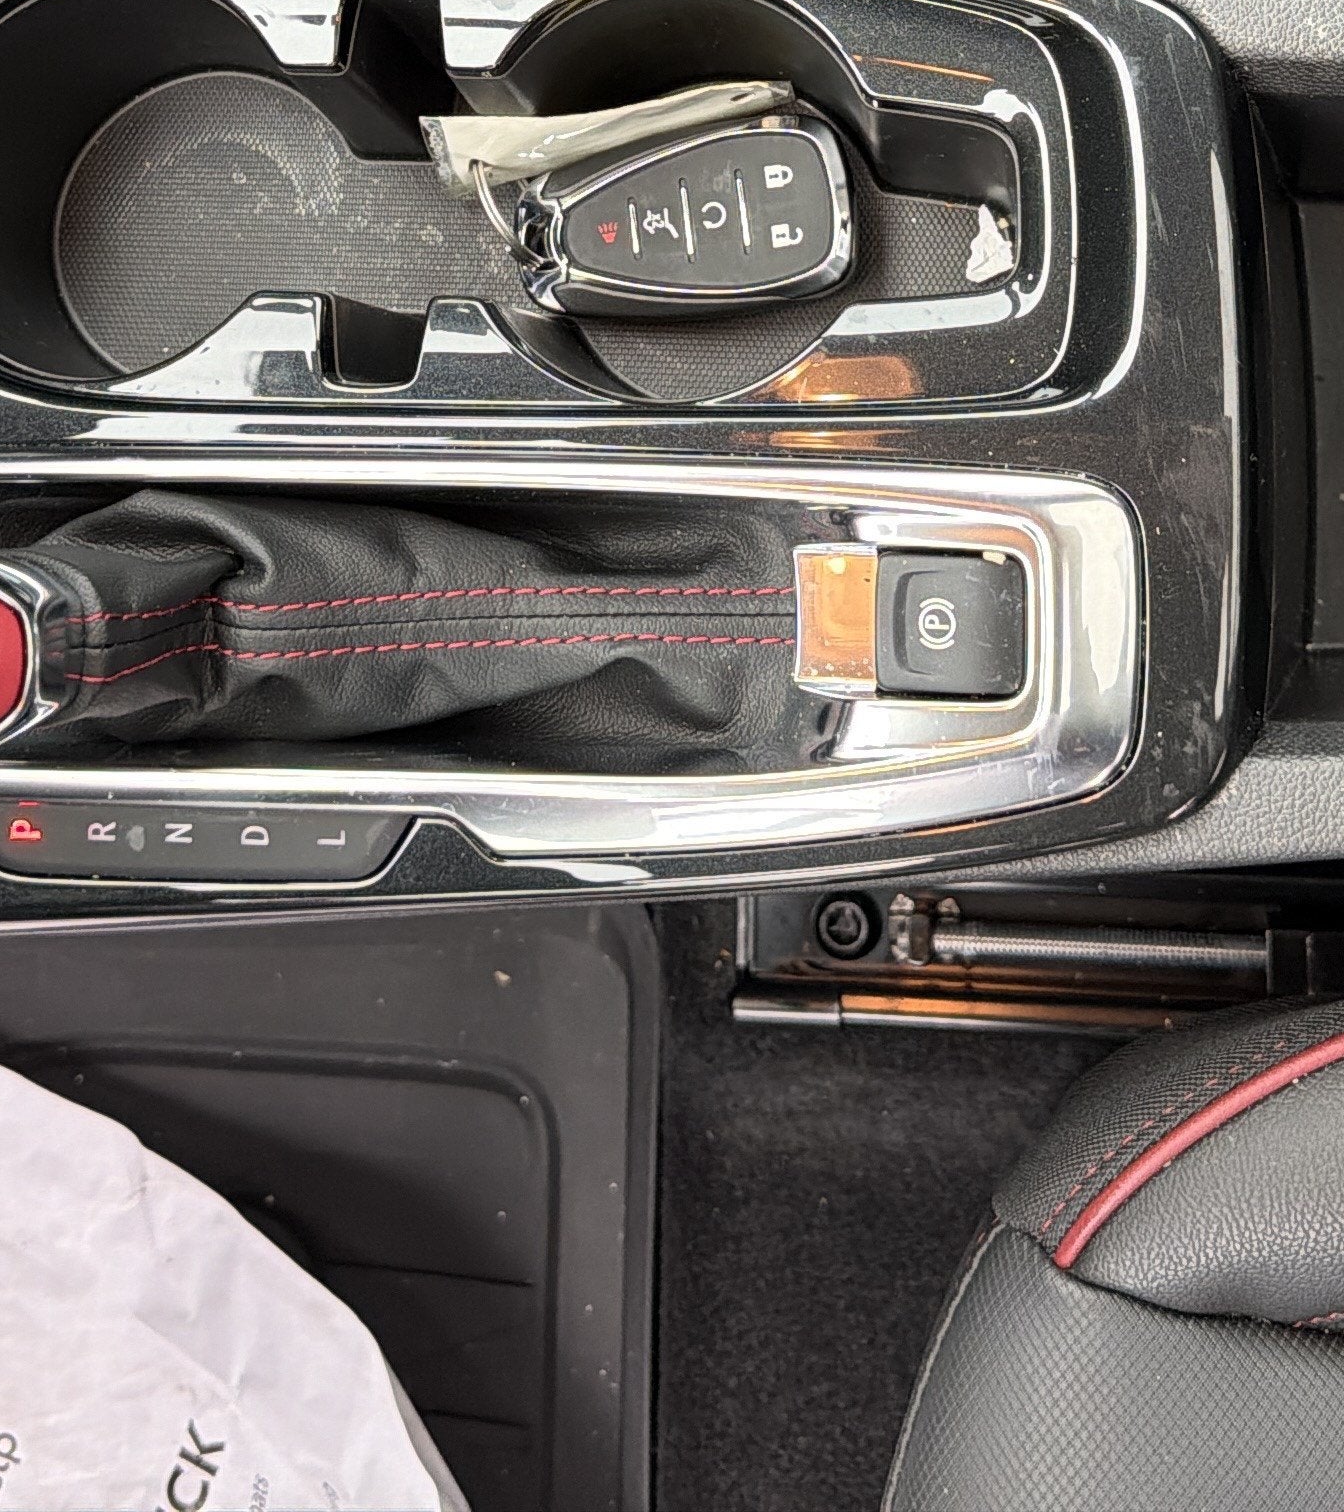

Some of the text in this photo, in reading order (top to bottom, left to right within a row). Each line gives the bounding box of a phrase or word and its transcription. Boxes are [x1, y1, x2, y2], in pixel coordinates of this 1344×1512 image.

[9, 818, 346, 846] P R N D L
